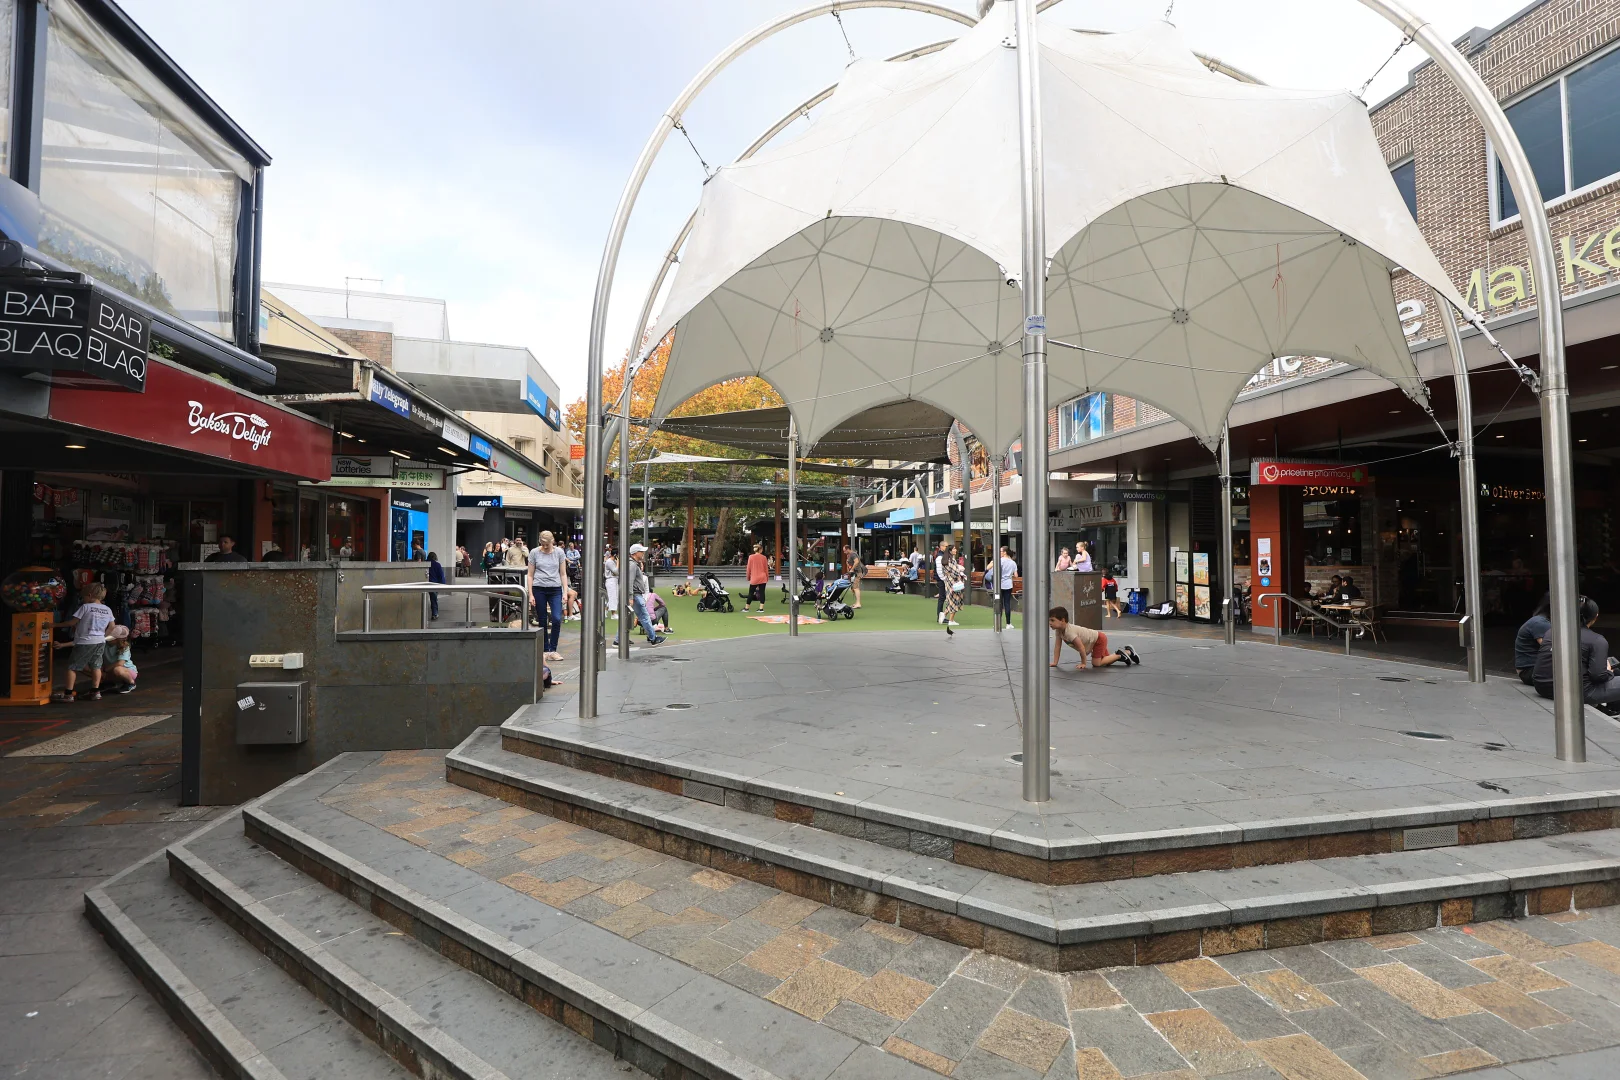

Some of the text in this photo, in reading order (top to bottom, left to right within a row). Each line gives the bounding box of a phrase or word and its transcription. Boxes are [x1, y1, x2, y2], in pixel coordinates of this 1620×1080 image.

[4, 291, 75, 319] BAR
[99, 303, 143, 343] BAR
[0, 328, 82, 359] BLAQ
[87, 335, 146, 382] BLAQ
[372, 379, 409, 412] aily Telegraph
[188, 400, 272, 450] Bakers Delight
[336, 465, 372, 474] Lotteries
[1280, 469, 1351, 479] priceline pharmacy
[1122, 492, 1156, 500] Woolworths
[1048, 518, 1064, 527] VIE
[1073, 505, 1103, 520] ENVIE
